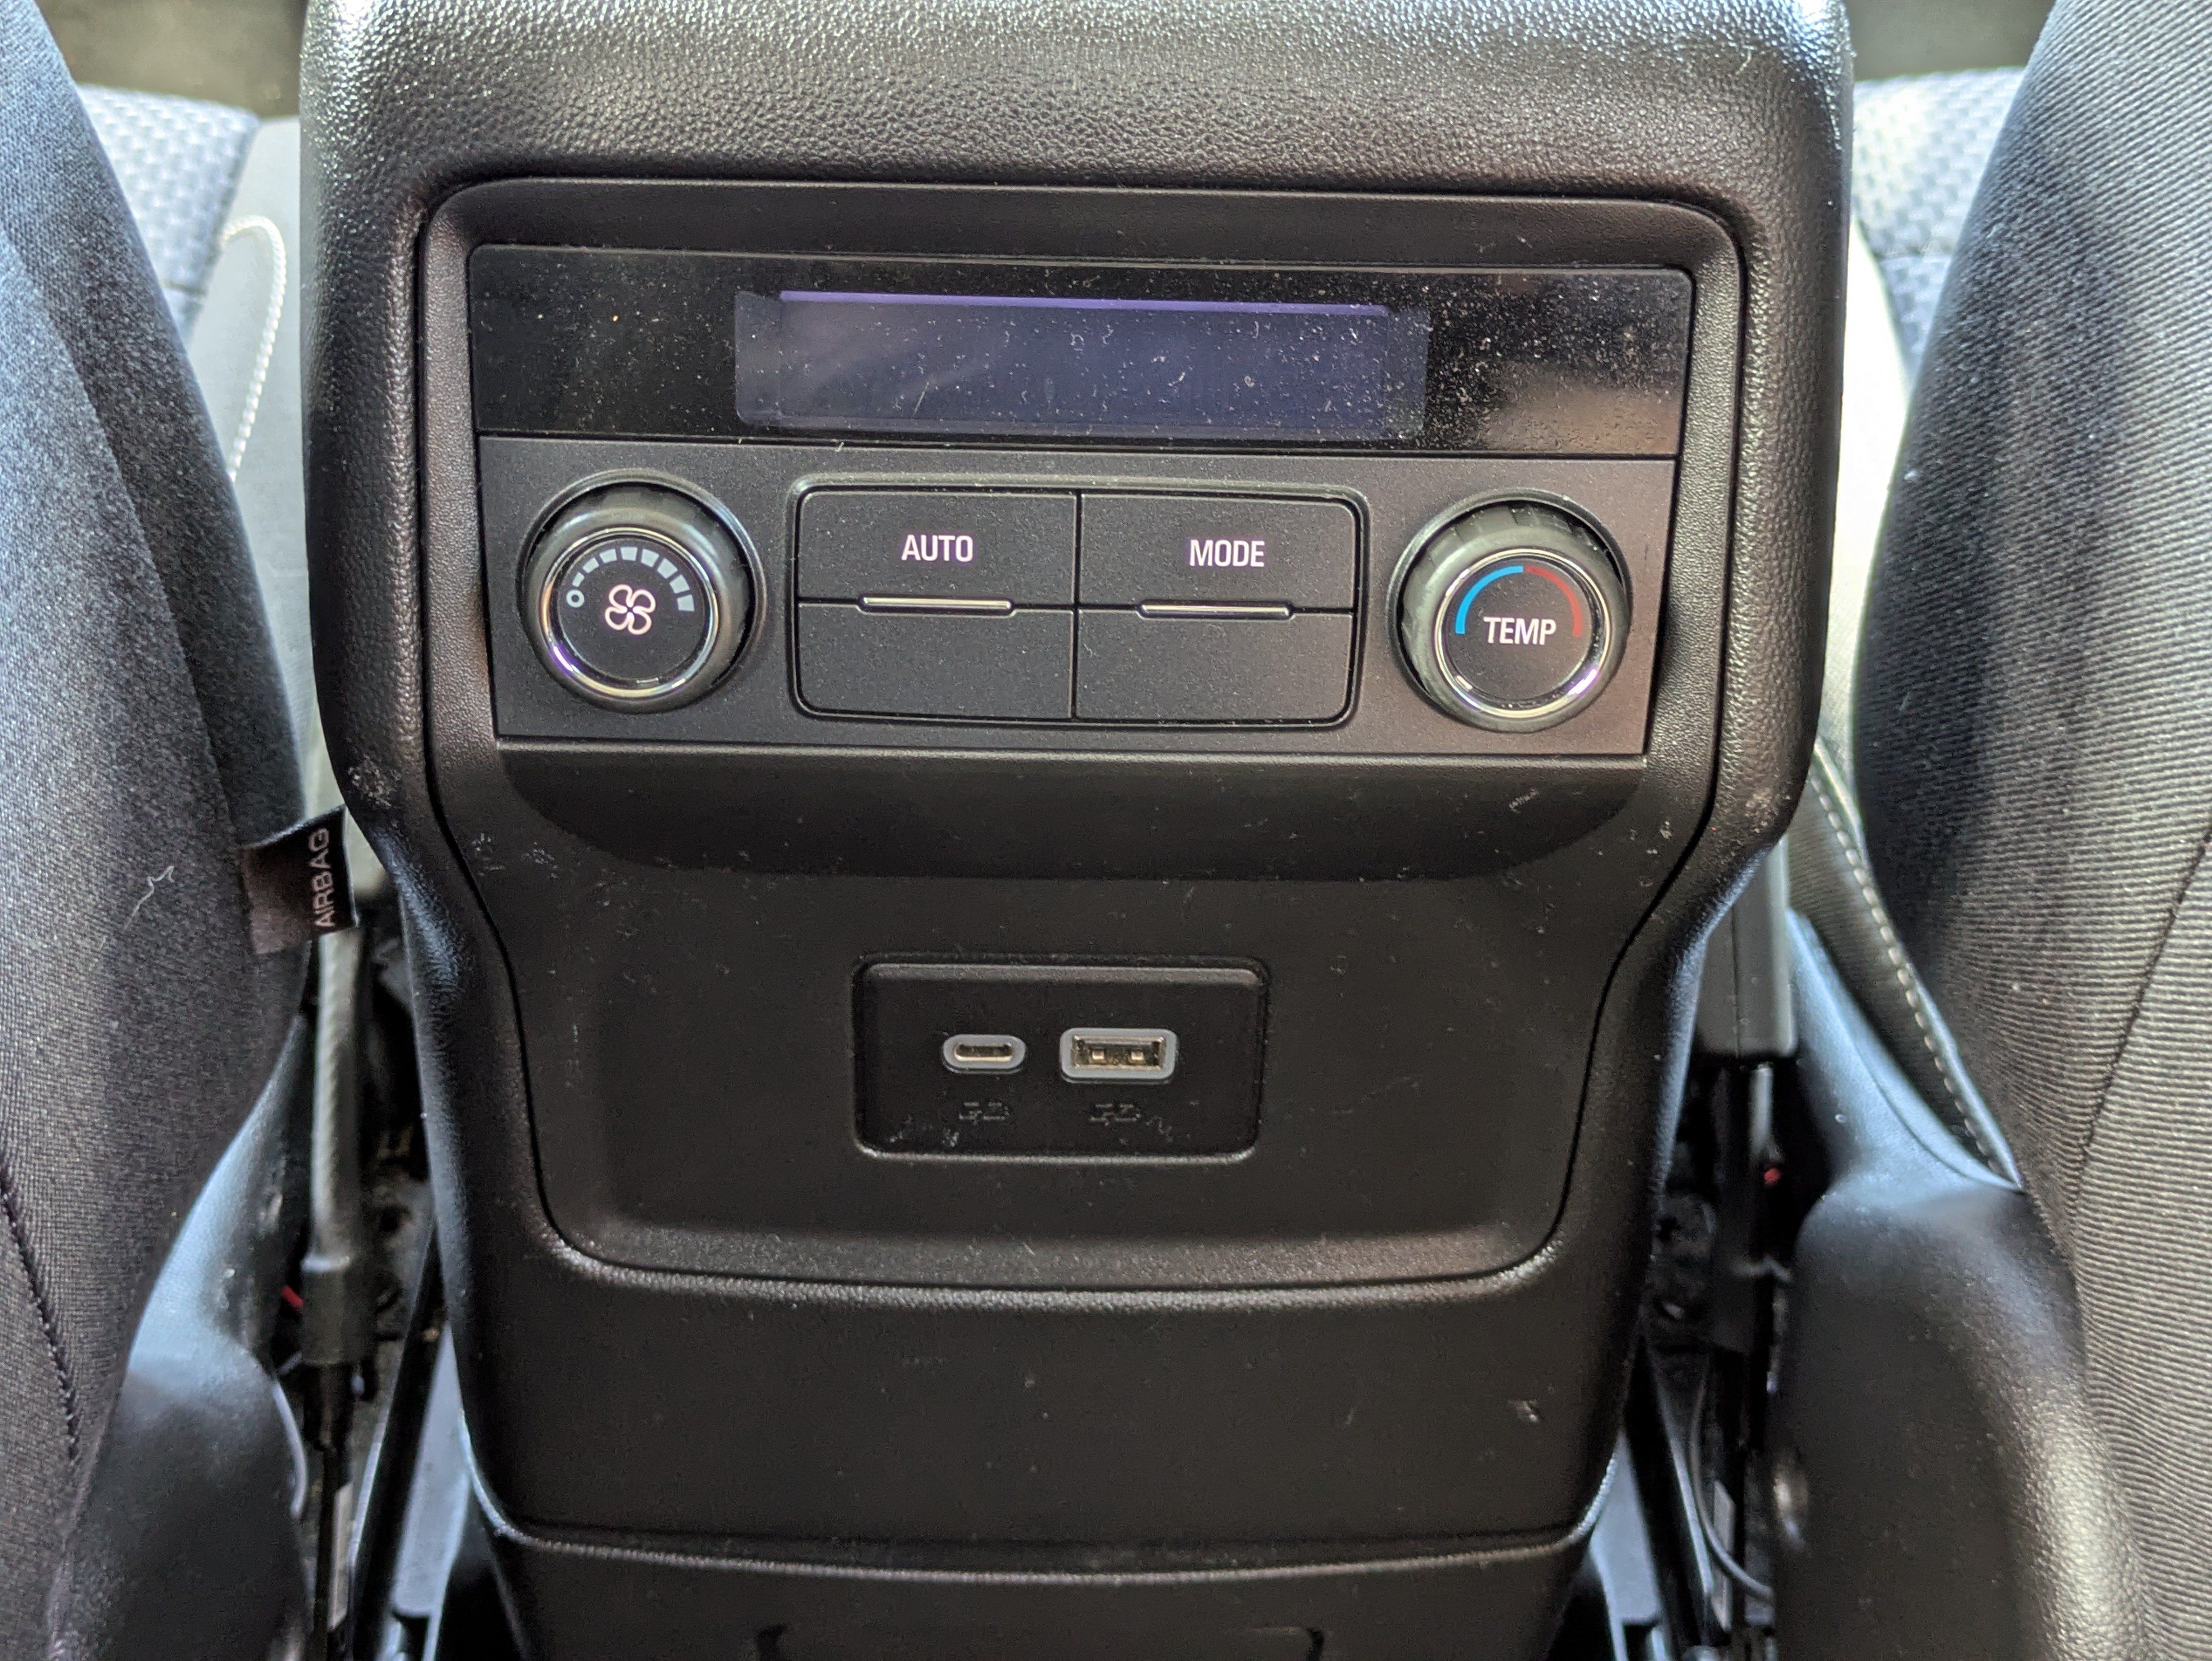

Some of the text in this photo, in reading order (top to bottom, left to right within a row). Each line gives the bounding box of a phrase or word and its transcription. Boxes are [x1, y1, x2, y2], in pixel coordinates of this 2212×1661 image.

[901, 534, 973, 562] AUTO
[1189, 539, 1265, 567] MODE
[1483, 616, 1557, 645] TEMP
[309, 827, 335, 928] AIRBAG
